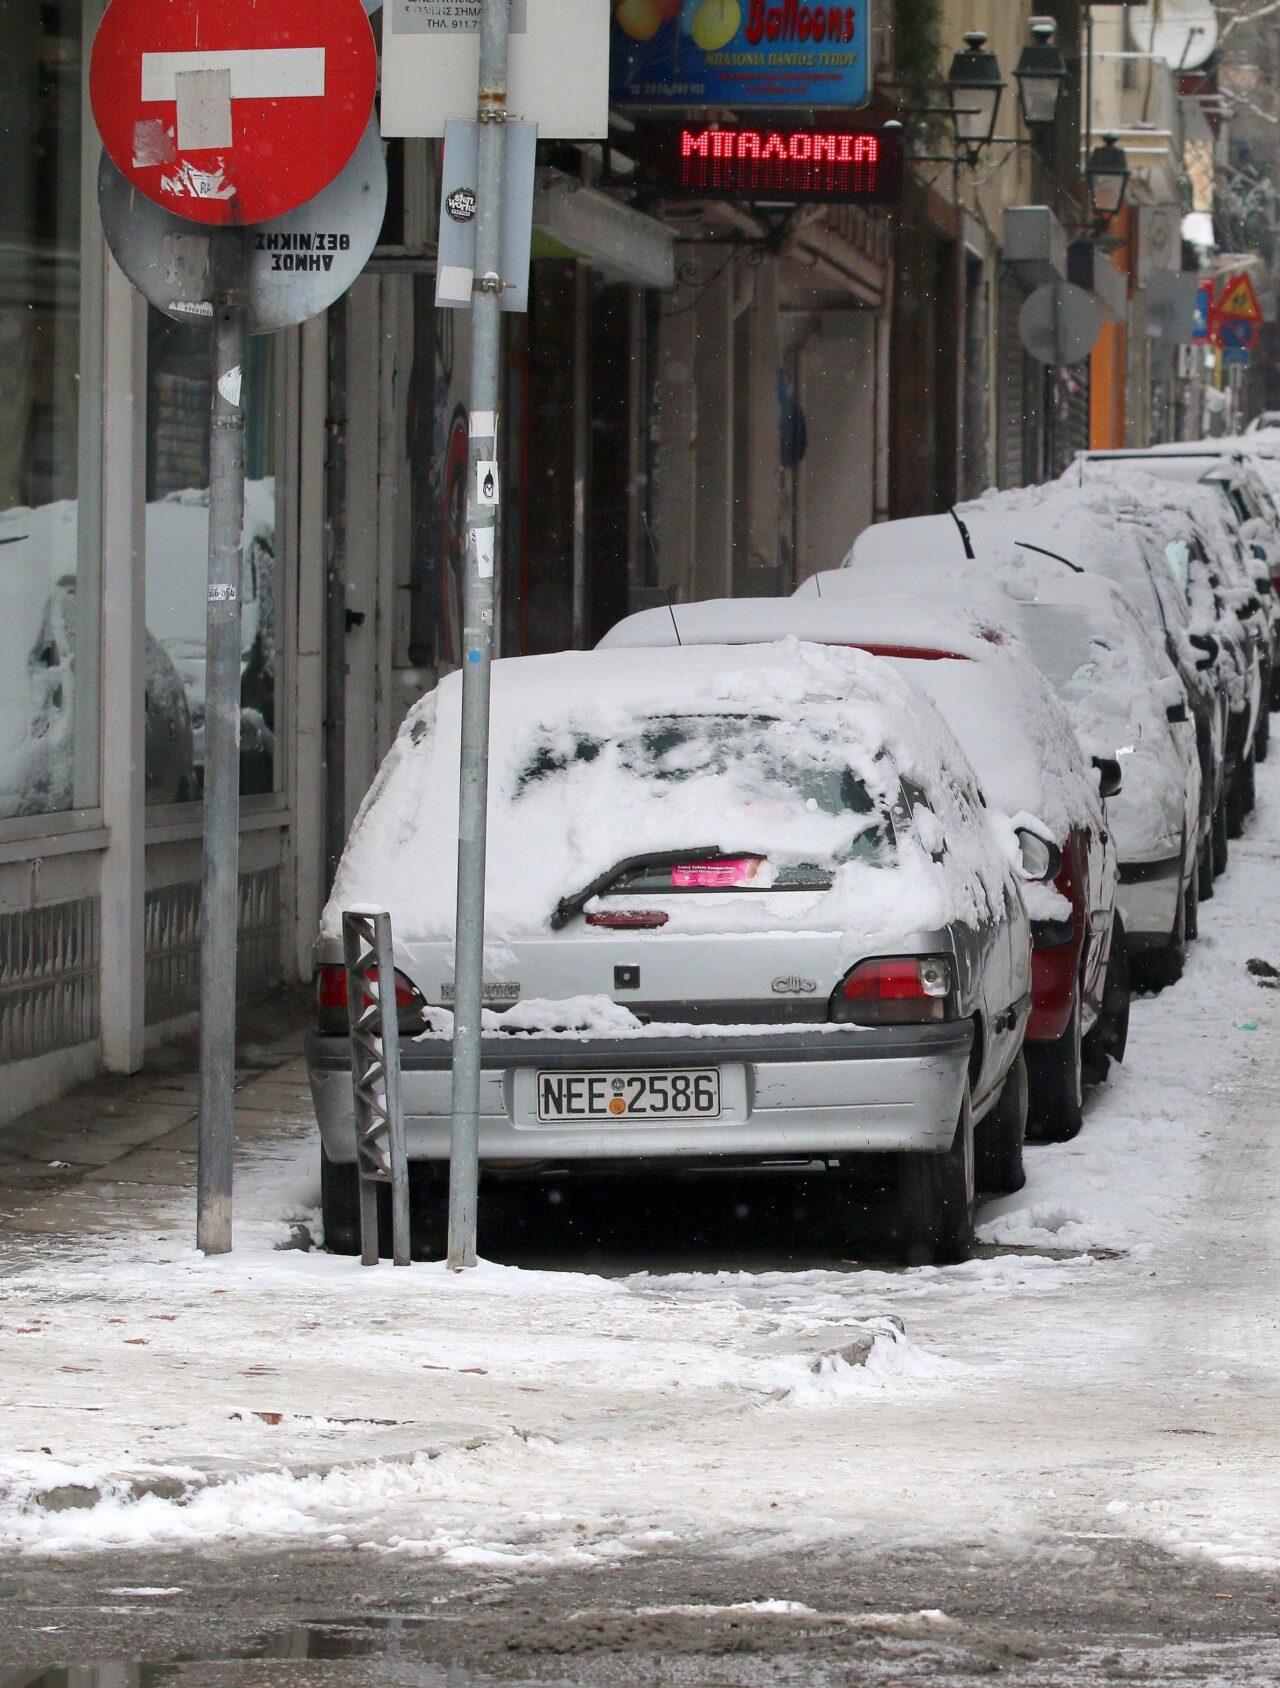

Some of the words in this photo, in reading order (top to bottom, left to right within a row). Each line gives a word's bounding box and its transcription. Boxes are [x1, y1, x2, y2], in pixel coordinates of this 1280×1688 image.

[426, 19, 449, 29] ΤΗΛ.
[451, 19, 482, 30] 911.7
[744, 0, 856, 45] Balloons
[681, 129, 879, 162] ΜΠΑΛΟΝΙΑ
[255, 231, 350, 251] ΘΕΣ/ΝΙΚΗΣ
[271, 253, 334, 271] ΔΗΜΟΣ
[772, 976, 817, 993] Clio
[626, 1075, 714, 1113] 2586
